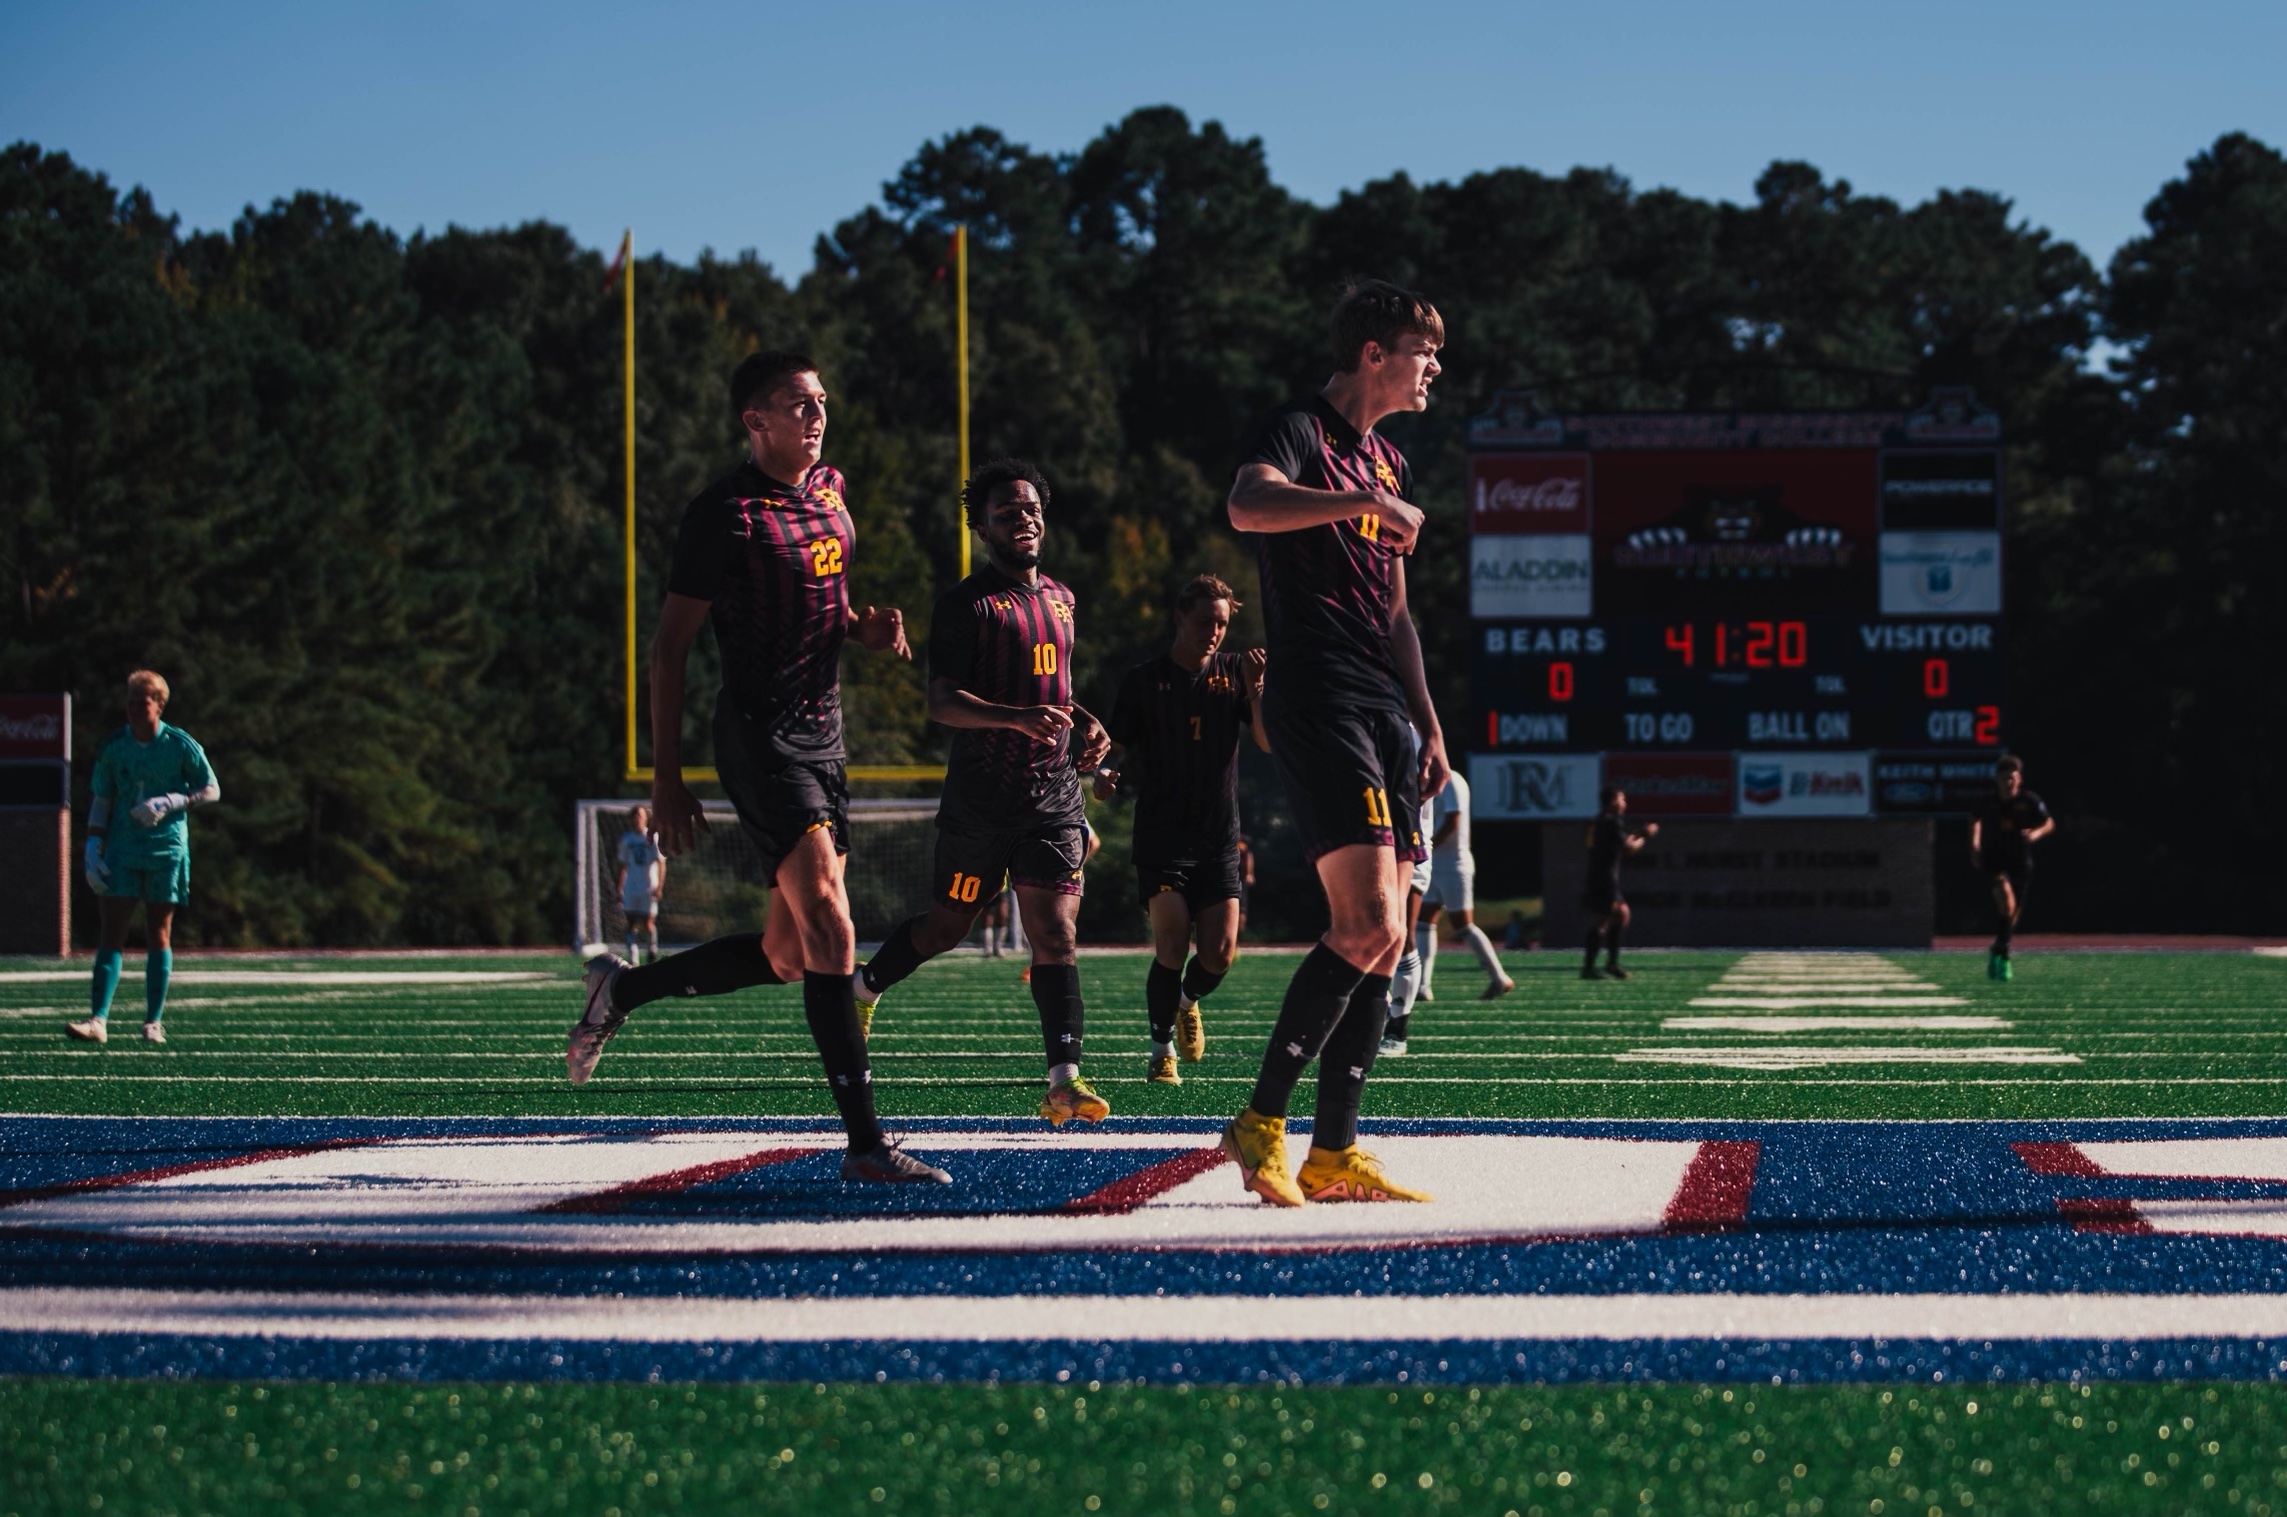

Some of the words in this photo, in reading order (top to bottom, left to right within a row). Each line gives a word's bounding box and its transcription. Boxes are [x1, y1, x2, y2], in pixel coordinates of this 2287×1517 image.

[1489, 477, 1582, 511] Coca-Cola
[810, 537, 843, 577] 22
[1474, 559, 1589, 581] ALADDIN
[1485, 631, 1606, 654] BEARS
[1860, 624, 1993, 649] VISITOR
[1033, 643, 1057, 675] 10
[1549, 662, 1573, 700] 0
[1924, 658, 1948, 697] 0
[1500, 713, 1568, 743] DOWN
[1624, 713, 1655, 742] TO
[1659, 712, 1693, 742] GO
[1748, 712, 1808, 742] BALL
[1814, 712, 1849, 742] ON
[1975, 705, 1999, 745] 2
[1363, 785, 1393, 827] 11
[949, 871, 981, 903] 10
